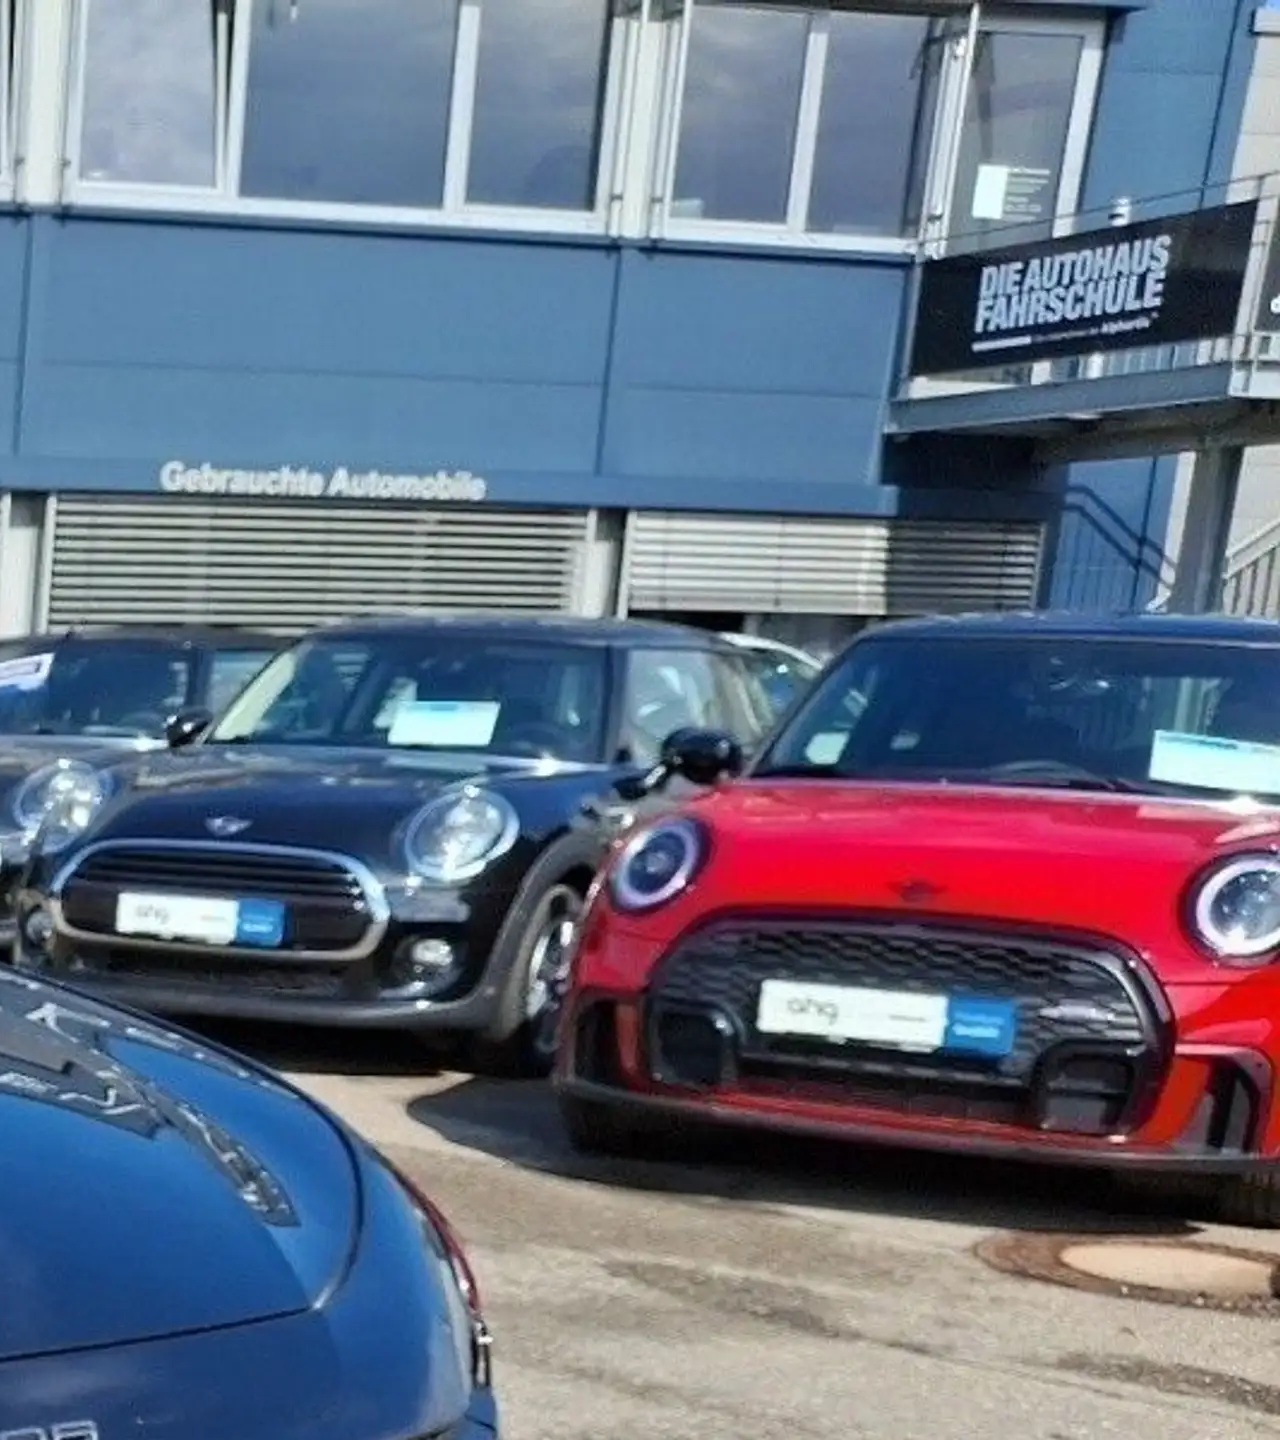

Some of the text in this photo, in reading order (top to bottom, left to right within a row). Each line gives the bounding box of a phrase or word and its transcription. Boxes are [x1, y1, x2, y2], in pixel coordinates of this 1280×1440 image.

[980, 235, 1172, 296] DIE AUTOHAUS
[974, 269, 1166, 333] FAHRSCHULE
[160, 460, 487, 500] Gebrauchte Automobile
